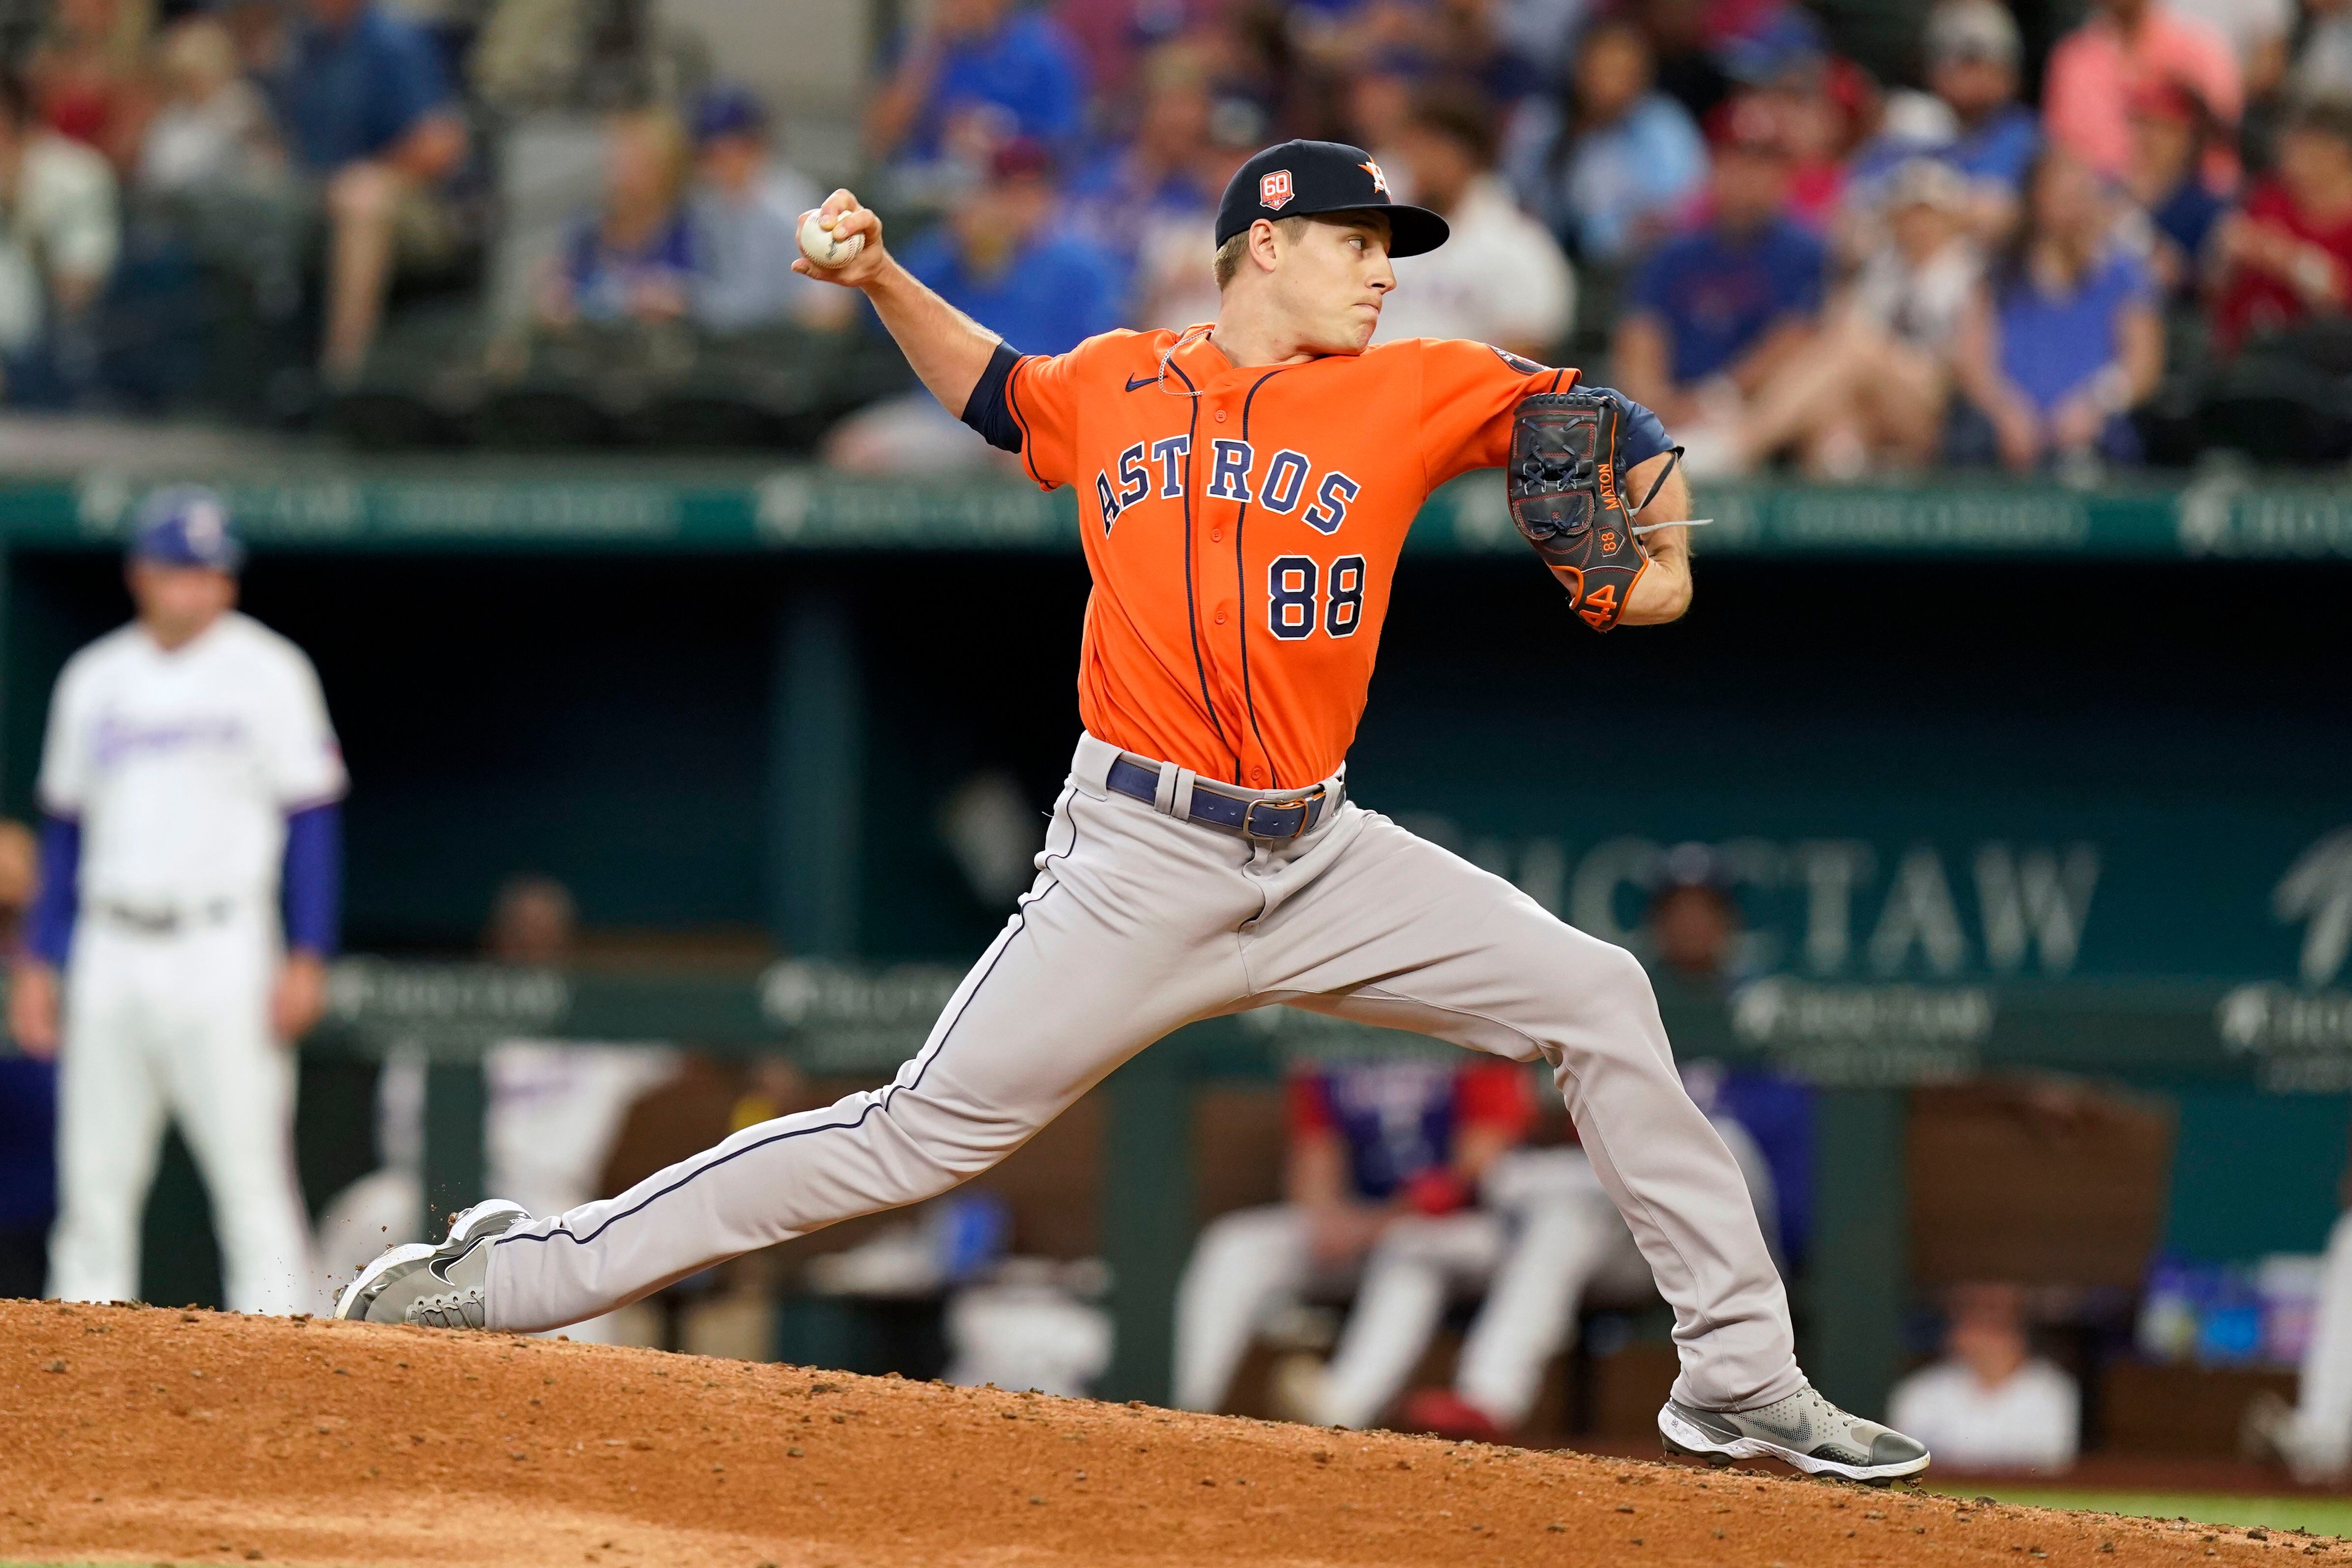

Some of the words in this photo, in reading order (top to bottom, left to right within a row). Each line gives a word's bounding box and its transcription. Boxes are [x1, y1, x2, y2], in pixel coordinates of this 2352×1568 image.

[1264, 174, 1288, 196] 60
[1095, 434, 1362, 540] ASTROS
[1597, 463, 1620, 510] MATON
[1601, 532, 1617, 552] 88
[1267, 554, 1367, 641] 88
[1579, 584, 1617, 627] 44
